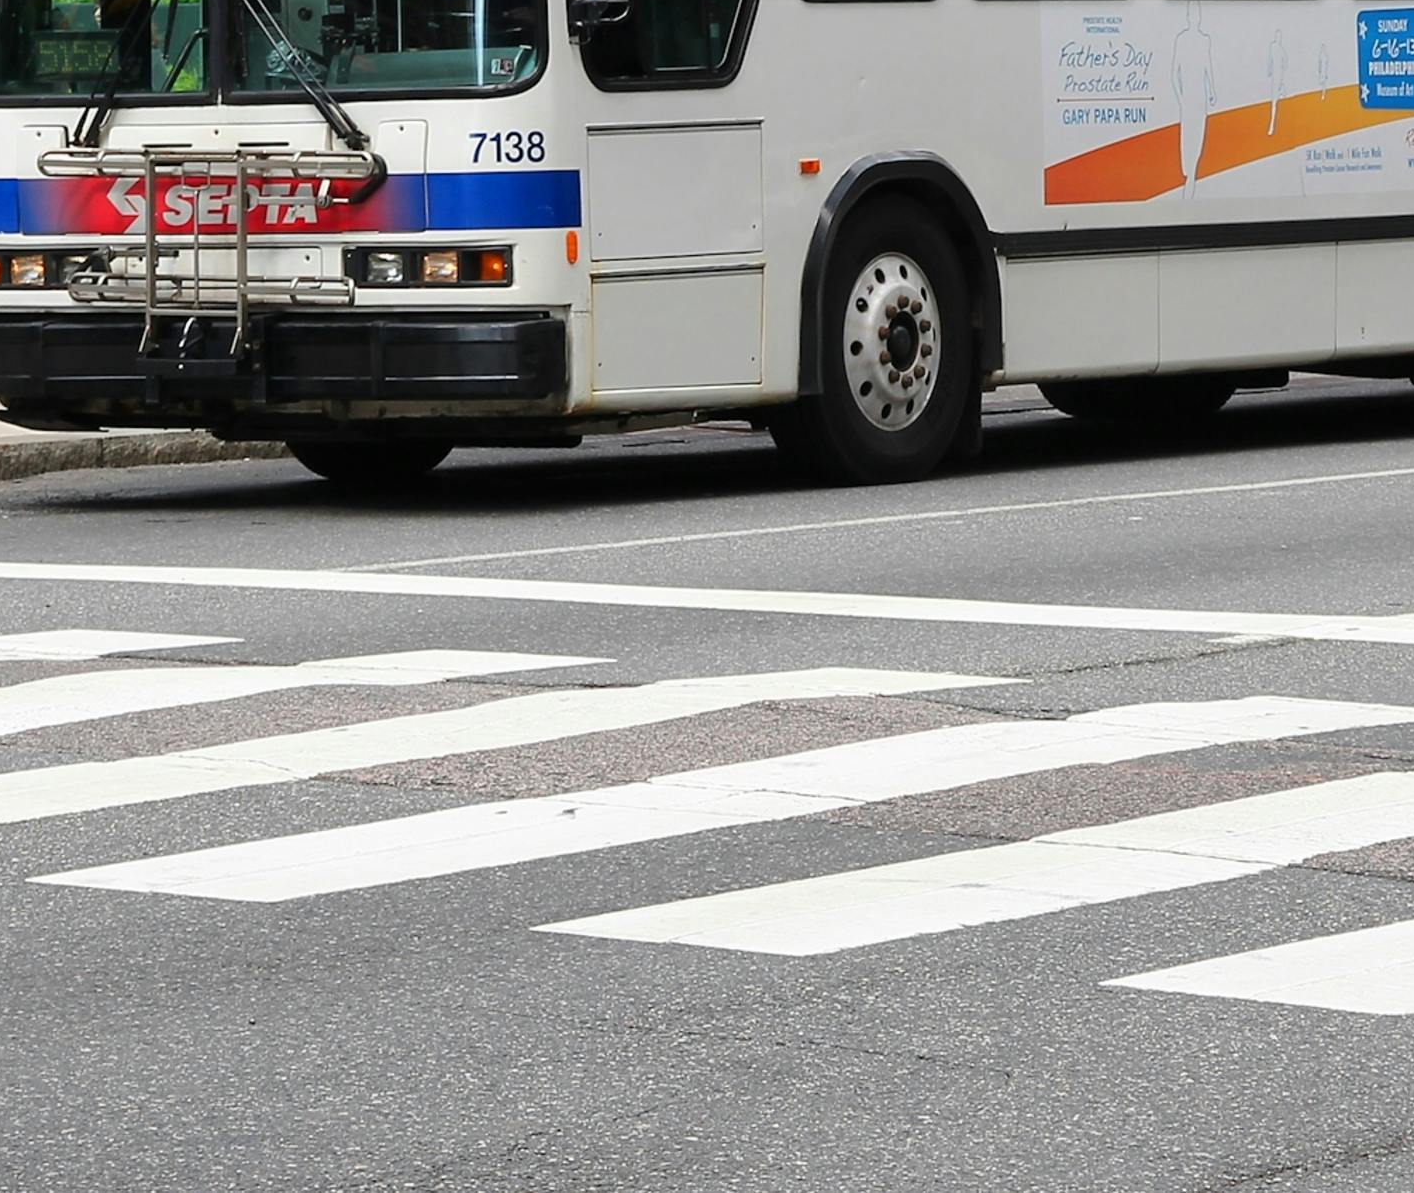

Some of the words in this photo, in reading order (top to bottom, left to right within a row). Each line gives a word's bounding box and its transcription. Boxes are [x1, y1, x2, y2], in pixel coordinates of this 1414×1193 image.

[1378, 19, 1408, 33] SUNDAY
[1059, 40, 1120, 68] Father's
[1124, 42, 1153, 75] Day
[1064, 73, 1122, 93] Prostate
[1126, 71, 1149, 92] Run
[1062, 108, 1091, 125] GARY
[1094, 108, 1122, 124] PAPA
[1124, 107, 1147, 123] RUN
[468, 131, 547, 163] 7138
[163, 183, 318, 225] SEPTA
